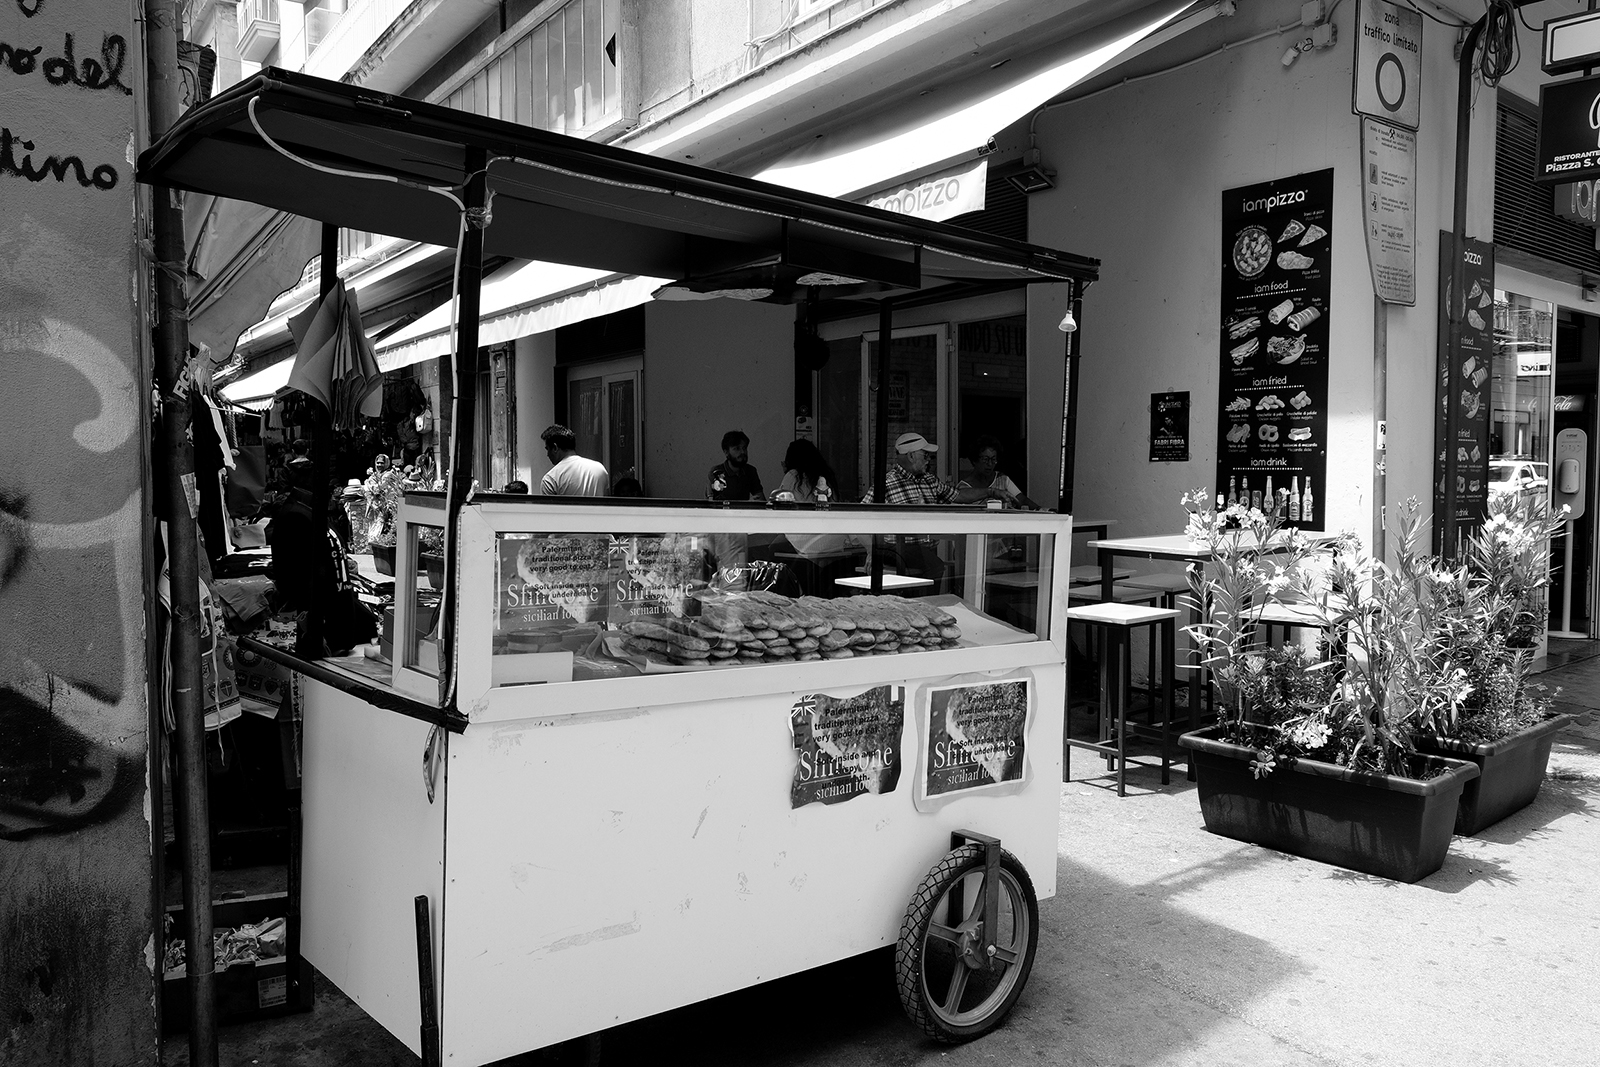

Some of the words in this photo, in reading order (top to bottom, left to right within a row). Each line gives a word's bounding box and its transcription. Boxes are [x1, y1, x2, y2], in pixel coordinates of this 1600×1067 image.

[1384, 12, 1400, 27] zona
[1364, 23, 1391, 43] traffico
[1393, 32, 1418, 54] limitato
[43, 31, 133, 96] del
[1545, 162, 1582, 173] Piazza
[1583, 158, 1594, 168] S.
[1242, 190, 1306, 213] iampizza
[1254, 283, 1270, 293] iam
[1270, 280, 1289, 291] food
[1252, 377, 1268, 387] iam
[1268, 375, 1287, 385] fried
[1250, 457, 1266, 467] iam
[1266, 456, 1288, 467] drink
[531, 554, 570, 563] traditional
[572, 554, 592, 563] pizza
[530, 565, 547, 573] very
[549, 564, 568, 573] good
[507, 583, 599, 607] Sfincone
[616, 579, 694, 602] Sfinone
[523, 608, 560, 622] sicilian
[825, 705, 870, 717] Palermitan
[814, 717, 857, 731] traditional
[859, 715, 879, 726] pizza
[973, 716, 990, 727] good
[812, 733, 831, 743] very
[832, 730, 853, 742] good
[855, 728, 863, 736] to
[933, 740, 1016, 769] Sfincone
[799, 747, 893, 782] Sfinone
[947, 768, 979, 785] sicilian
